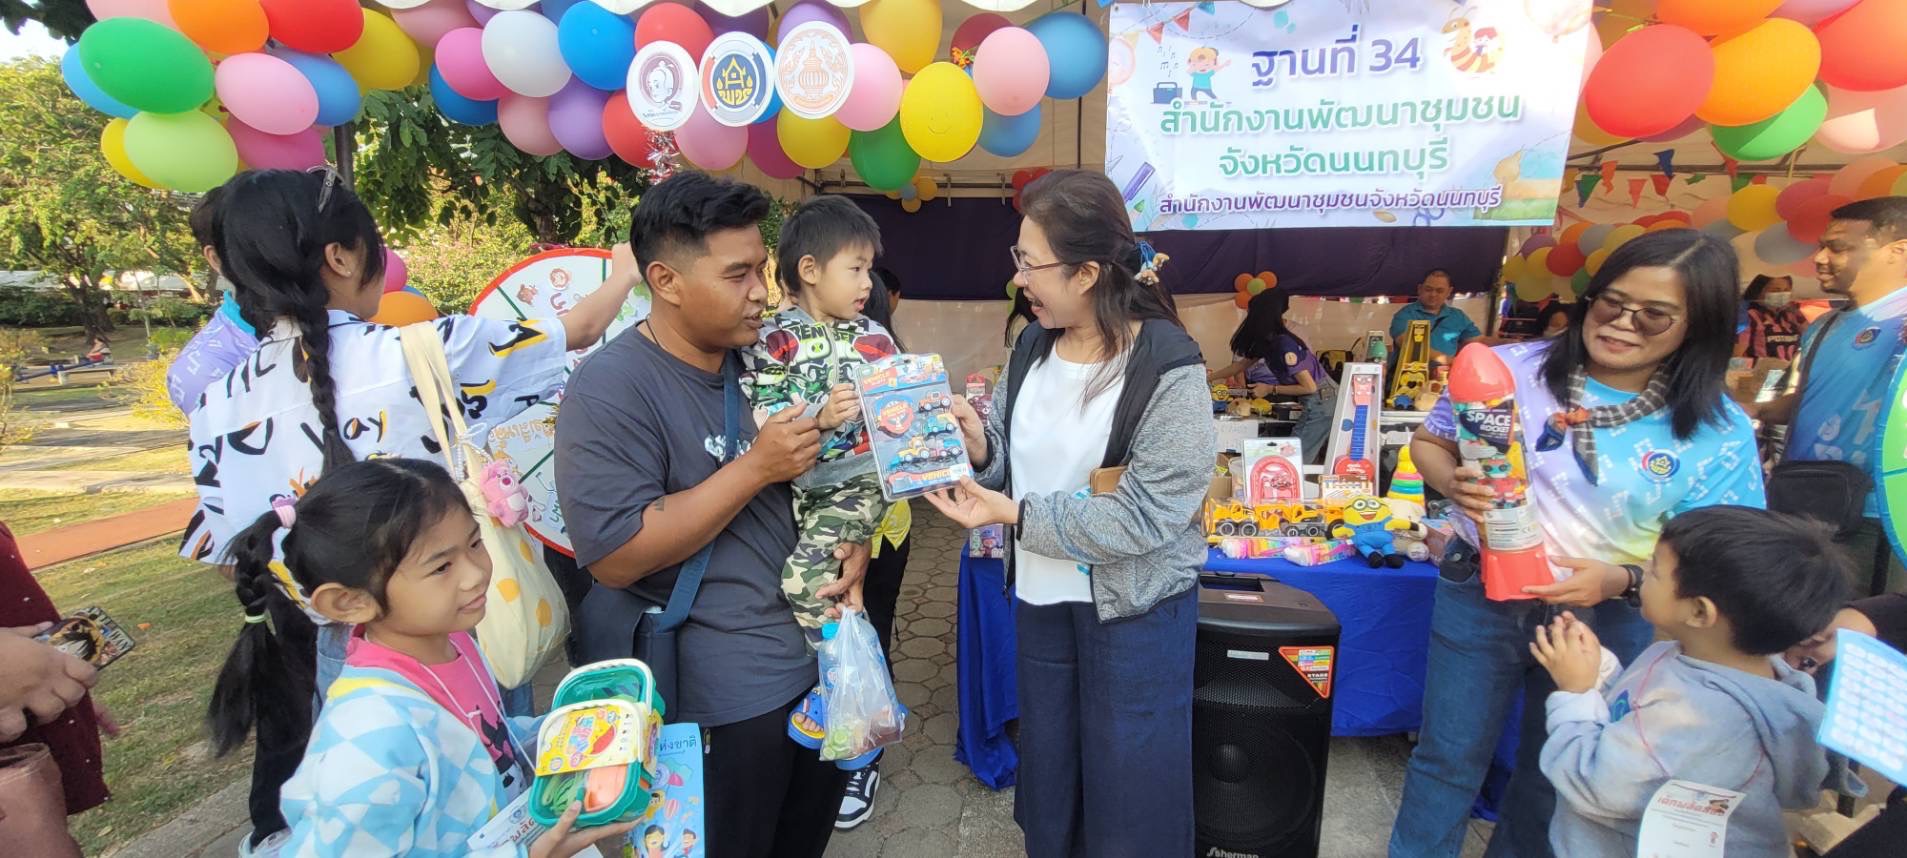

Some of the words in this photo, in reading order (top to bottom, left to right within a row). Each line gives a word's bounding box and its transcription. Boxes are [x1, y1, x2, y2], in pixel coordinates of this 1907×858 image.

[1252, 25, 1358, 86] ฐานที่
[1369, 37, 1420, 72] 34
[1160, 94, 1520, 133] สำนักงานพัฒนาชุมชน
[1219, 137, 1448, 179] จังหวัดนนทบุรี
[1160, 186, 1503, 213] สำนักงานพัฒนาชุมชนจังหวัดนนทบุรี
[1466, 411, 1511, 426] SPACE
